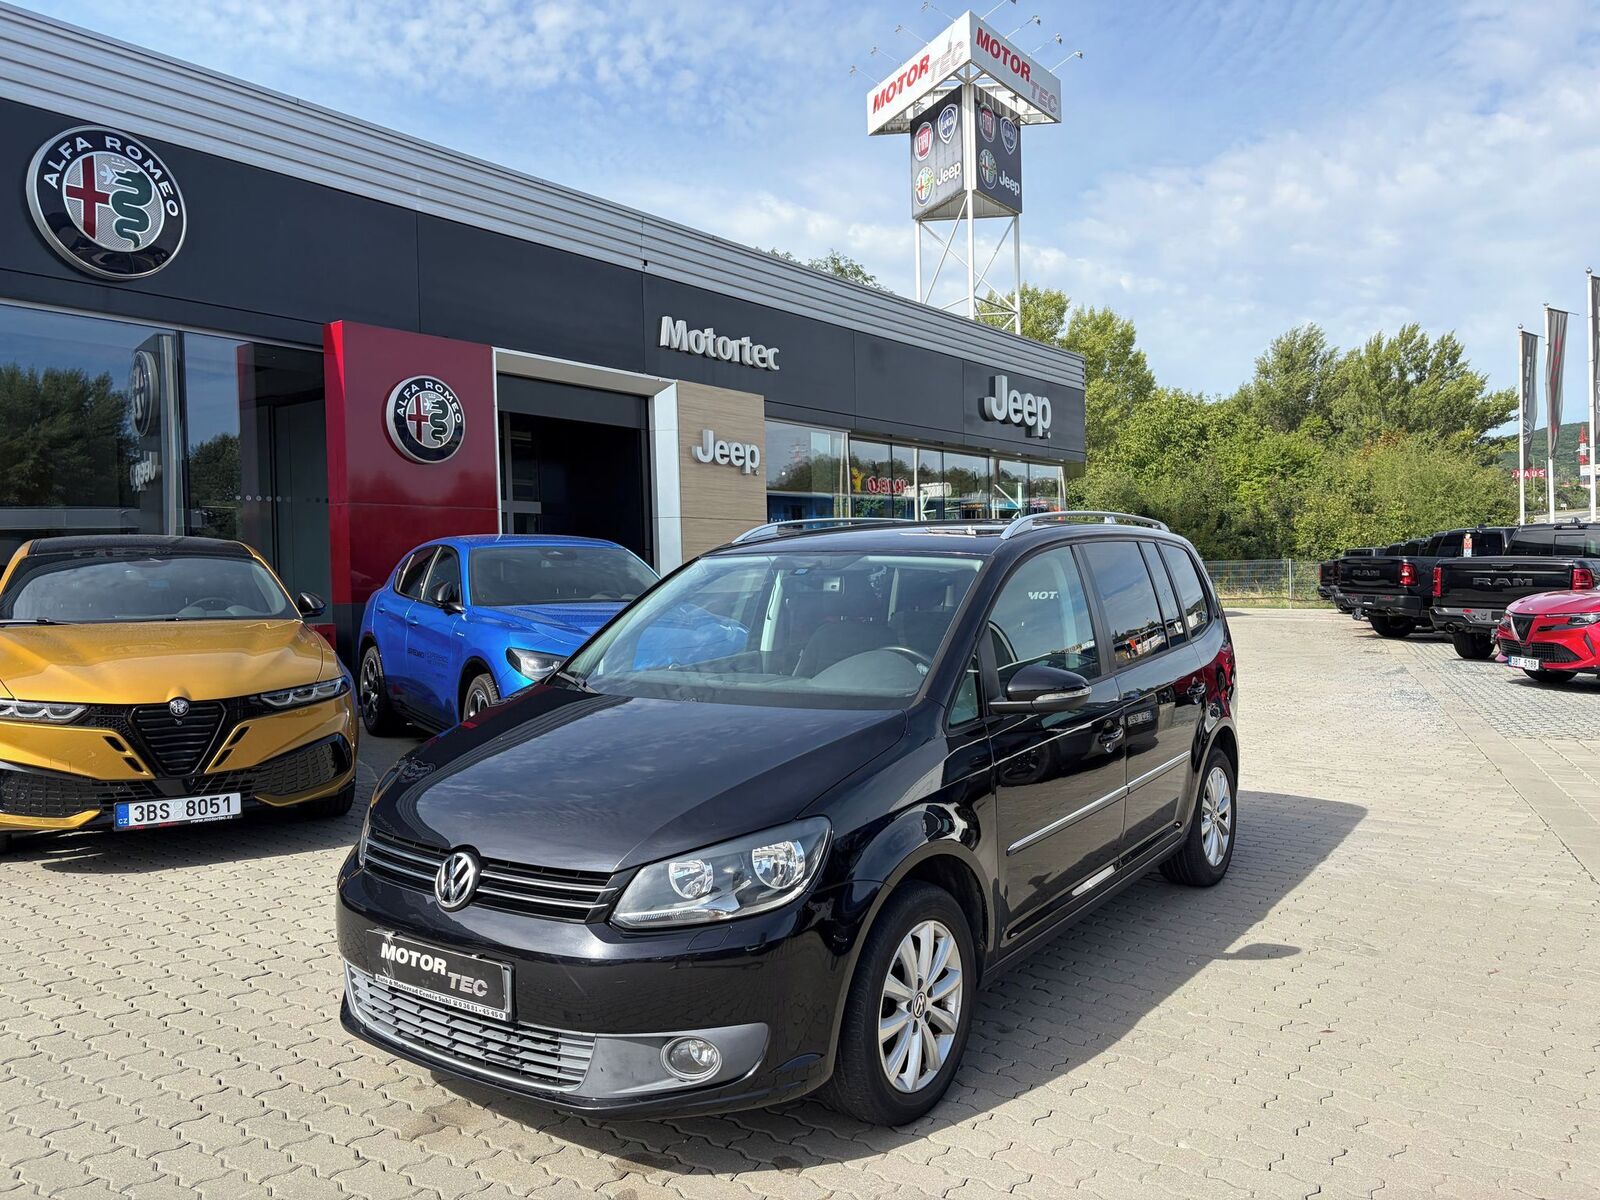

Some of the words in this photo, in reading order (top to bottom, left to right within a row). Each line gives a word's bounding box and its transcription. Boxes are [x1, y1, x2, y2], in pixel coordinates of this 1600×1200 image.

[873, 54, 930, 114] MOTOR
[930, 40, 964, 82] TEC
[976, 27, 1031, 82] MOTOR
[1030, 79, 1057, 113] TEC
[43, 136, 93, 190] ALFA
[104, 135, 179, 217] ROMEO
[936, 162, 962, 186] Jeep
[999, 170, 1020, 196] Jeep
[659, 315, 781, 371] Motortec
[396, 384, 420, 417] ALFA
[424, 380, 462, 423] ROMEO
[978, 375, 1052, 438] Jeep
[692, 429, 761, 475] Jeep
[1352, 569, 1381, 577] RAM
[1472, 577, 1534, 586] RAM
[134, 803, 170, 823] 3BS
[185, 796, 231, 817] 8051
[380, 942, 447, 976] MOTOR
[447, 971, 488, 997] TEC
